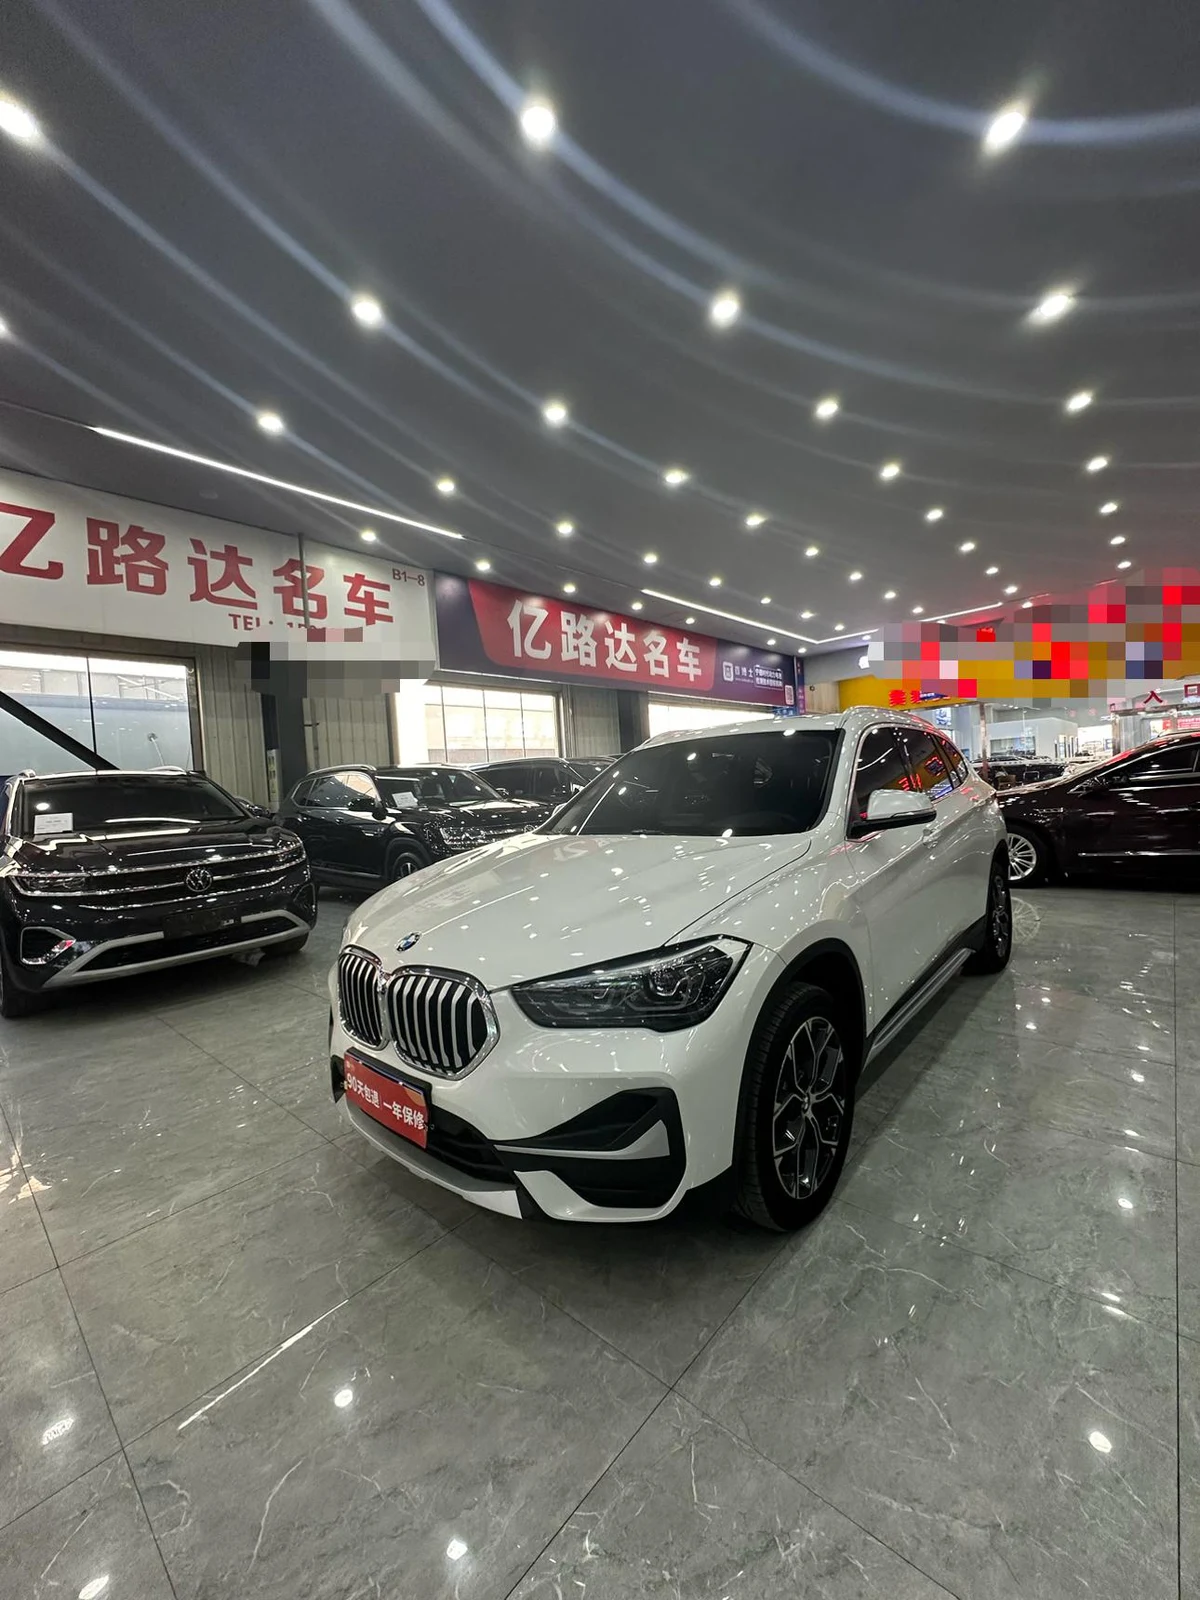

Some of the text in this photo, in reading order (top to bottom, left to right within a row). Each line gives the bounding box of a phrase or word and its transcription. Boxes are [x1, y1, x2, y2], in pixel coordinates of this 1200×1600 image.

[507, 599, 702, 682] 亿路达名车
[383, 1101, 426, 1130] 一年保修
